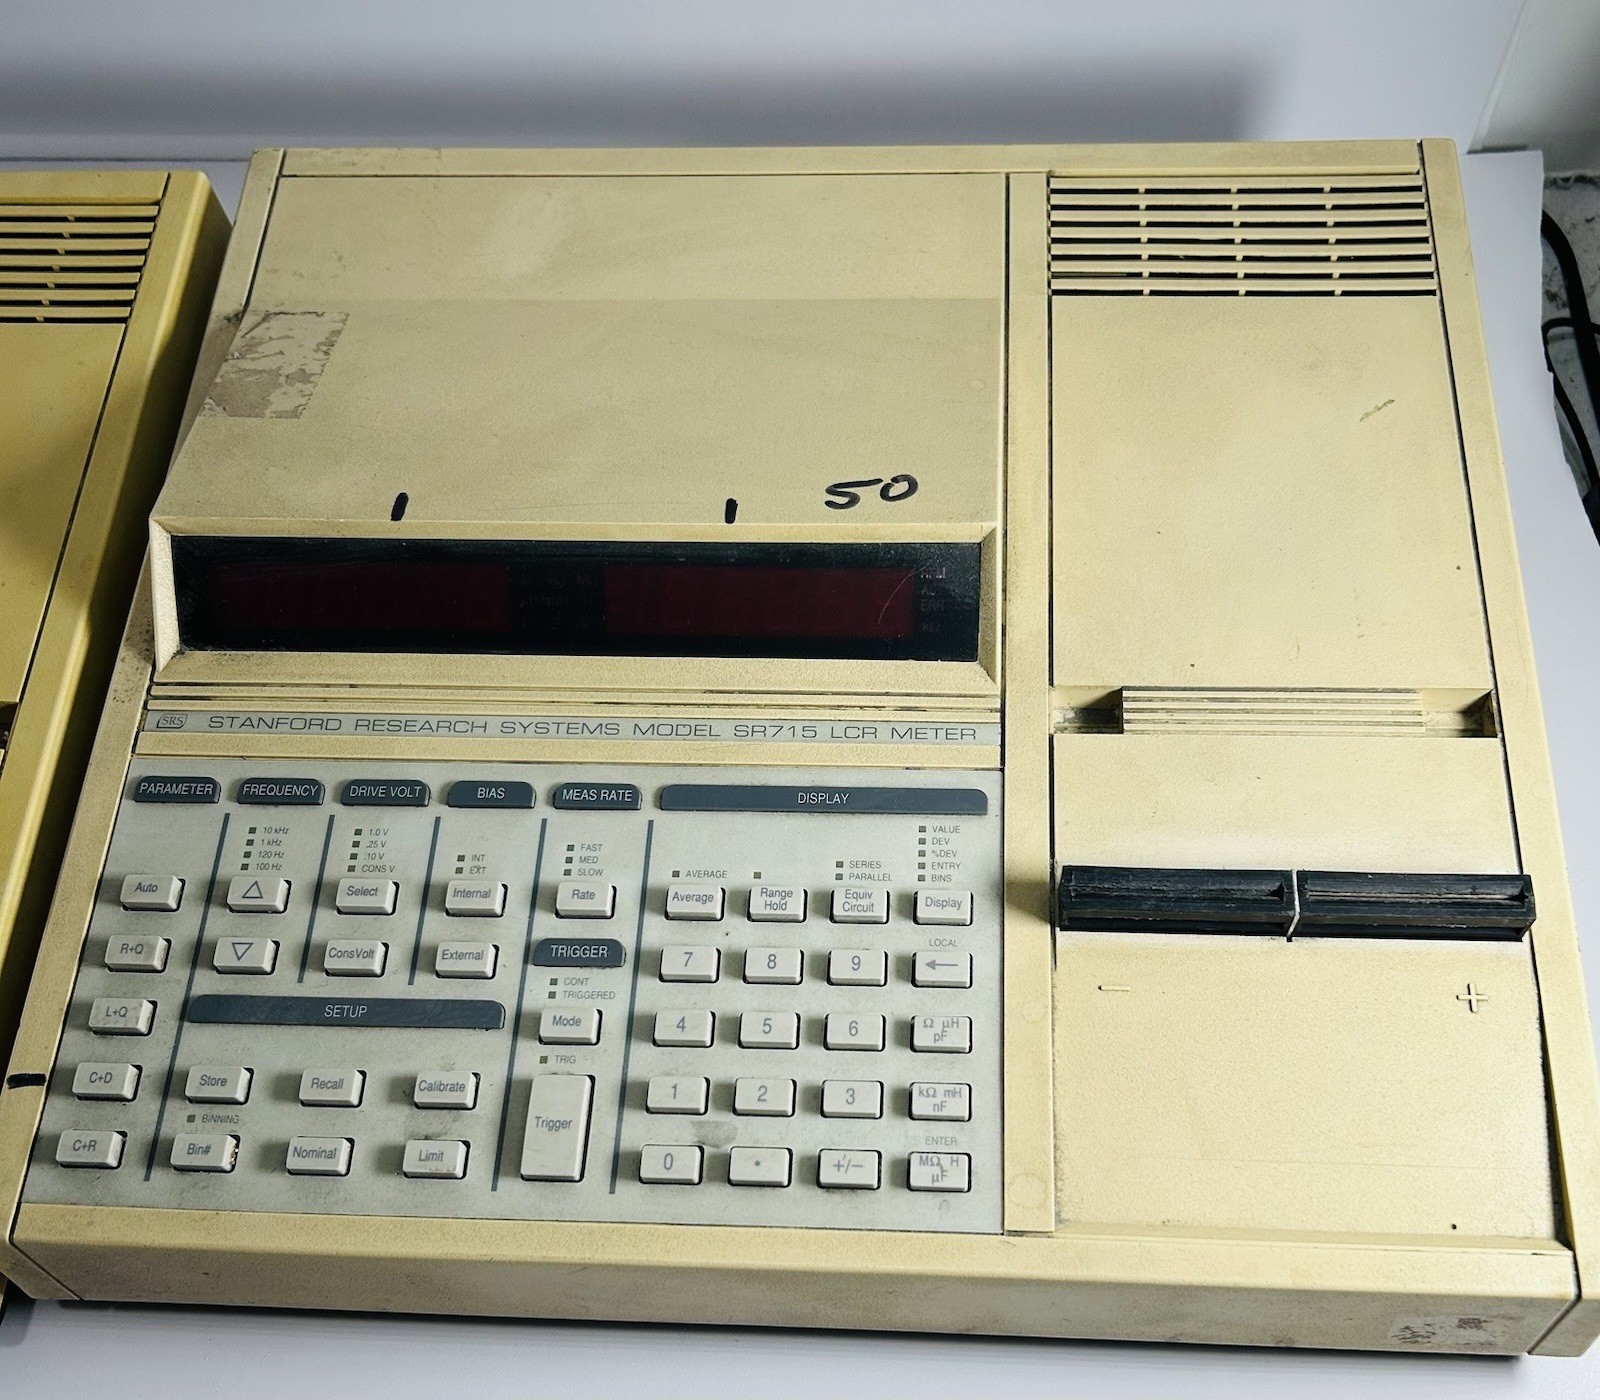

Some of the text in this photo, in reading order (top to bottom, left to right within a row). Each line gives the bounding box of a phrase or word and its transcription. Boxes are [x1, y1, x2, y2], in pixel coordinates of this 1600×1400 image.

[824, 473, 919, 510] 50
[161, 715, 184, 727] SRS
[208, 715, 977, 741] STANFORD RESEARCH SYSTEMS MODEL SR715 LCR METER
[139, 782, 214, 795] PARAMETER
[242, 784, 319, 797] FREQUENCY
[350, 785, 423, 798] DRIVE VOLT
[477, 787, 506, 800] BIAS
[562, 789, 633, 802] MEAS RATE
[797, 792, 850, 805] DISPLAY
[263, 826, 290, 835] 10 kHz
[368, 828, 390, 837] 1.0 V
[931, 824, 961, 835] VALUE
[261, 838, 283, 847] 1 kHz
[365, 840, 388, 849] .25 V
[580, 843, 604, 852] FAST
[931, 836, 951, 846] DEV
[258, 850, 285, 860] 120 Hz
[363, 852, 385, 861] .10 V
[471, 854, 486, 862] INT
[579, 855, 599, 864] MED
[931, 849, 958, 859] %DEV
[255, 862, 283, 872] 100 Hz
[361, 864, 396, 874] CONS V
[469, 866, 487, 875] EXT
[848, 860, 882, 870] SERIES
[931, 861, 961, 870] ENTRY
[577, 868, 604, 877] SLOW
[685, 869, 728, 879] AVERAGE
[848, 872, 893, 882] PARALLEL
[930, 873, 952, 883] BINS
[134, 881, 159, 894] Auto
[346, 884, 379, 897] Select
[452, 887, 492, 900] Internal
[571, 888, 596, 901] Rate
[672, 891, 714, 906] Average
[759, 887, 794, 902] Range
[844, 888, 873, 902] Equiv
[763, 899, 788, 912] Hold
[842, 900, 875, 913] Circuit
[924, 896, 963, 911] Display
[119, 942, 144, 955] R+Q
[928, 938, 960, 948] LOCAL
[328, 946, 375, 960] ConsVolt
[441, 948, 484, 962] External
[550, 945, 609, 959] TRIGGER
[683, 951, 694, 968] 7
[766, 953, 778, 970] 8
[851, 954, 862, 971] 9
[563, 977, 590, 986] CONT
[562, 990, 616, 1000] TRIGGERED
[105, 1005, 128, 1018] L+Q
[324, 1004, 368, 1018] SETUP
[551, 1014, 582, 1027] Mode
[676, 1019, 687, 1034] 4
[762, 1018, 773, 1035] 5
[848, 1020, 860, 1037] 6
[933, 1030, 948, 1044] pF
[554, 1054, 577, 1064] TRIG
[89, 1071, 113, 1084] C+D
[199, 1074, 228, 1088] Store
[310, 1077, 345, 1091] Recall
[418, 1079, 466, 1094] Calibrate
[670, 1083, 679, 1099] 1
[757, 1085, 768, 1102] 2
[845, 1088, 856, 1105] 3
[932, 1100, 948, 1113] nF
[201, 1114, 240, 1124] BINNING
[534, 1116, 573, 1132] Trigger
[72, 1139, 98, 1152] C+R
[924, 1136, 958, 1146] ENTER
[186, 1143, 212, 1157] Bin#
[292, 1146, 337, 1161] Nominal
[418, 1149, 445, 1163] Limit
[663, 1153, 674, 1171] 0
